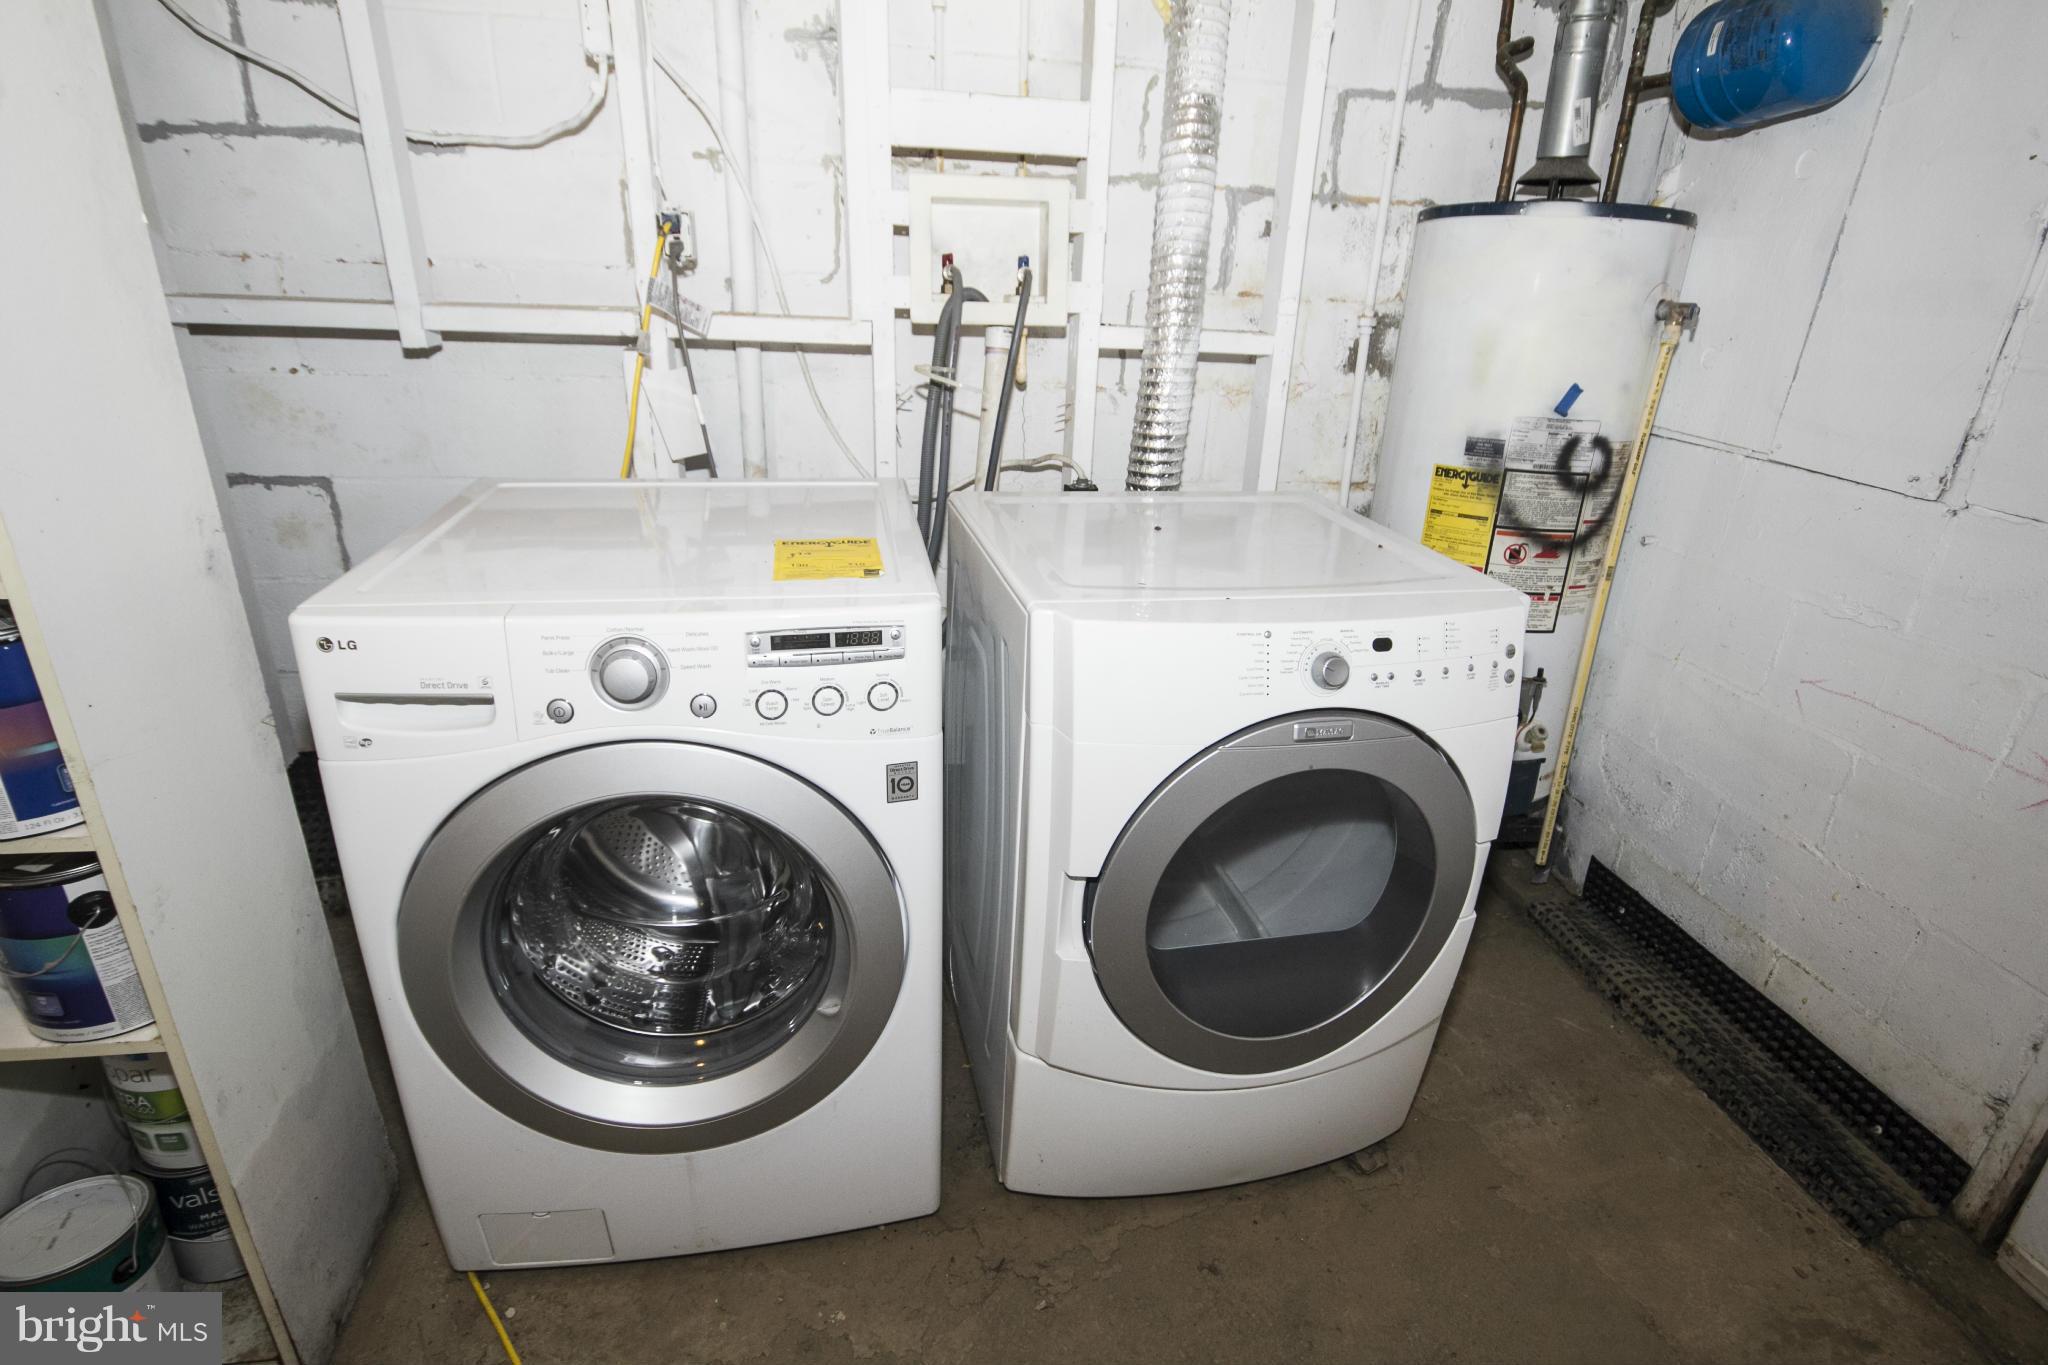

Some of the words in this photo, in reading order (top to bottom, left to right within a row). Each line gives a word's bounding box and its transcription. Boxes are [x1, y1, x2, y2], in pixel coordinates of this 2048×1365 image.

[337, 639, 358, 650] LG
[420, 681, 445, 689] Direct
[447, 681, 469, 689] Drive
